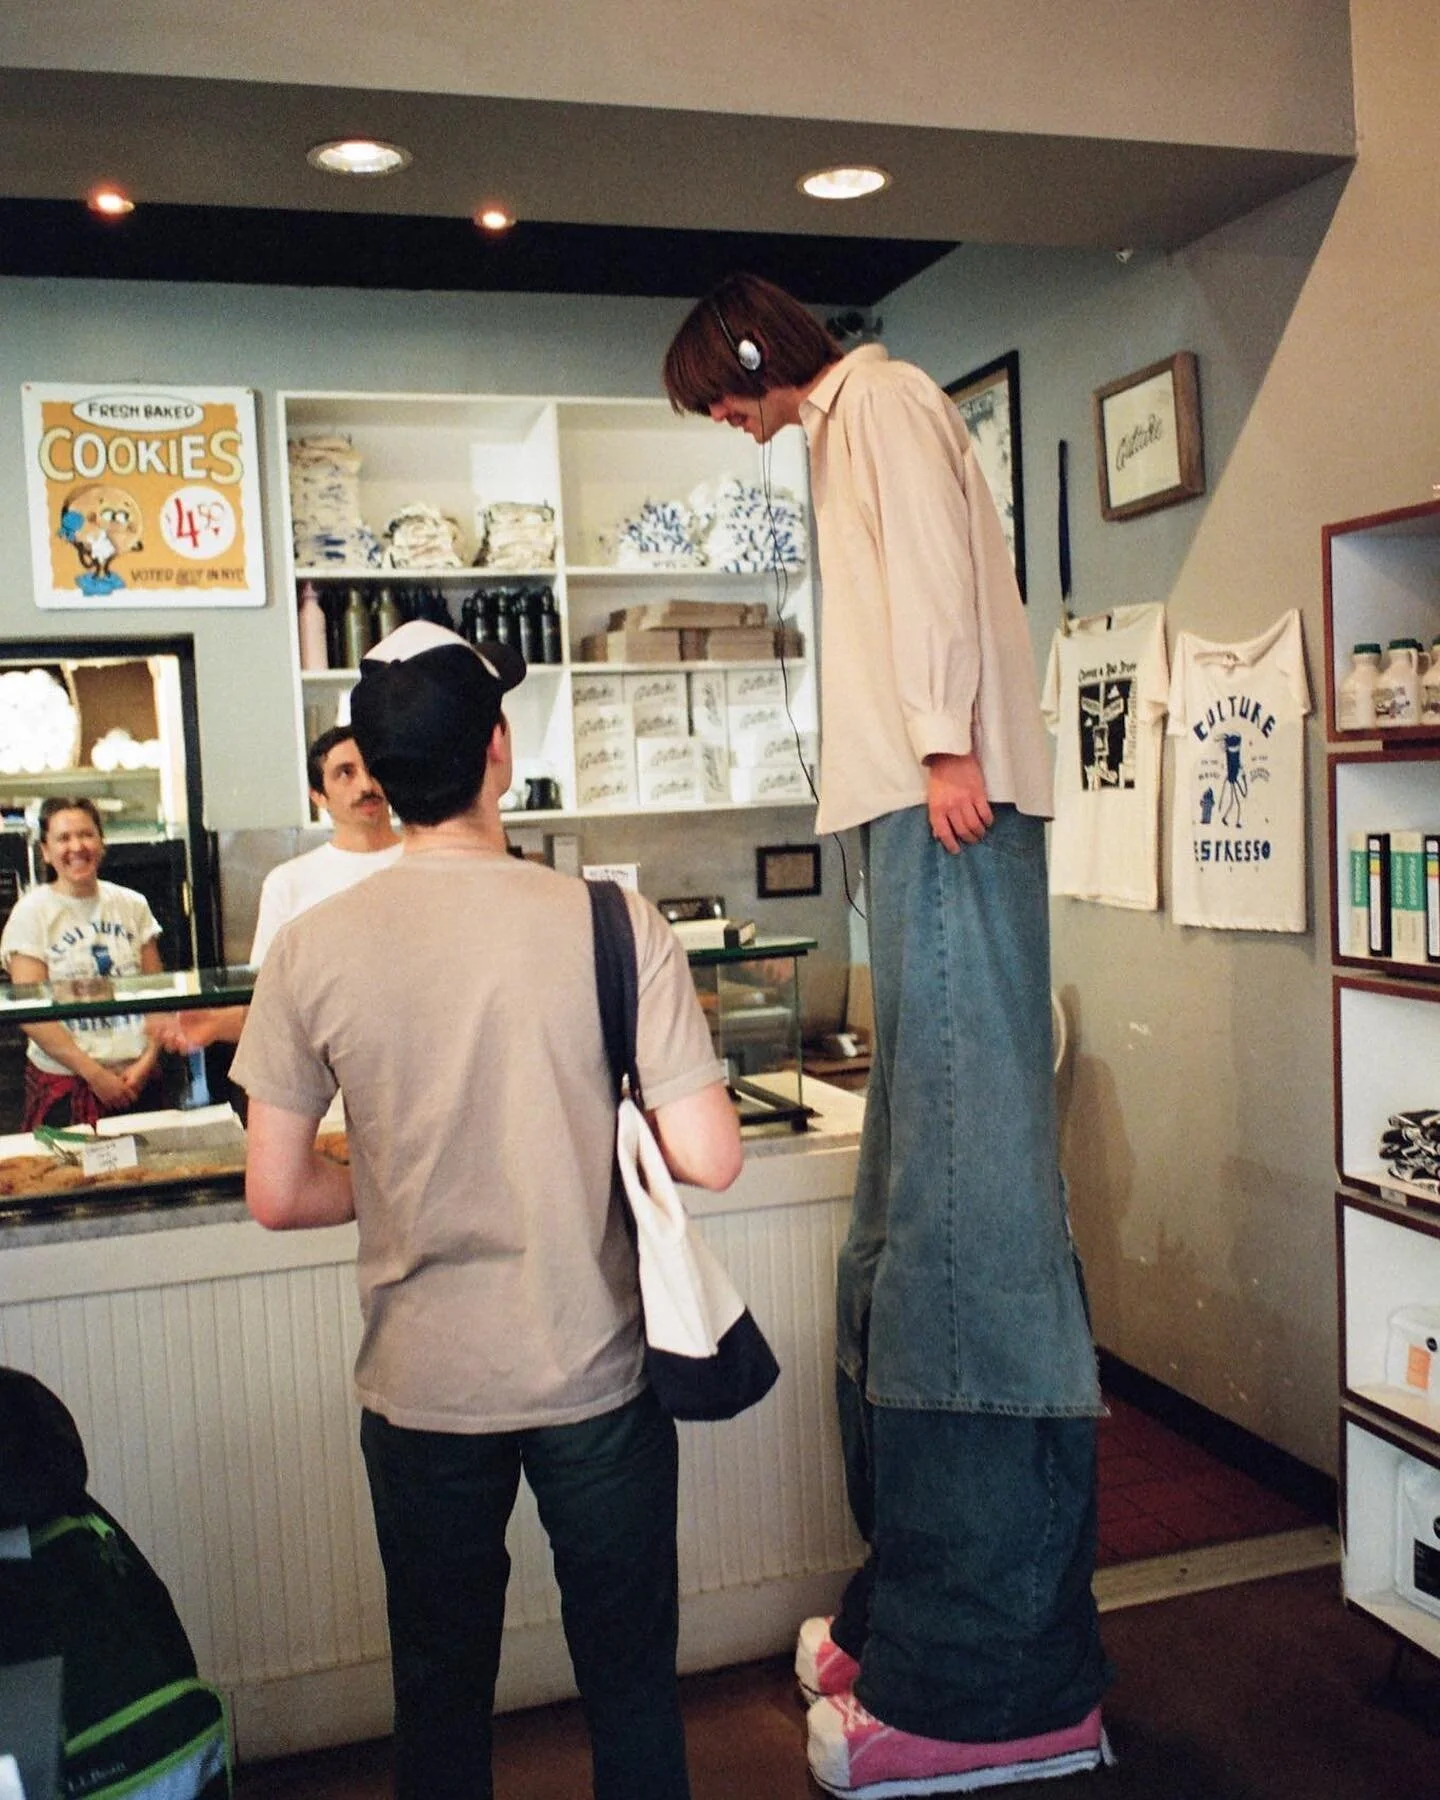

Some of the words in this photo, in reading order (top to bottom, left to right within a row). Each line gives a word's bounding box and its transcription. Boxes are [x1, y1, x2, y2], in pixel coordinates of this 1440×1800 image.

[88, 403, 139, 419] FRESH
[143, 403, 195, 419] BAKED
[39, 427, 244, 485] COOKIES
[130, 567, 174, 582] VOTED
[1193, 695, 1276, 742] CULTURE
